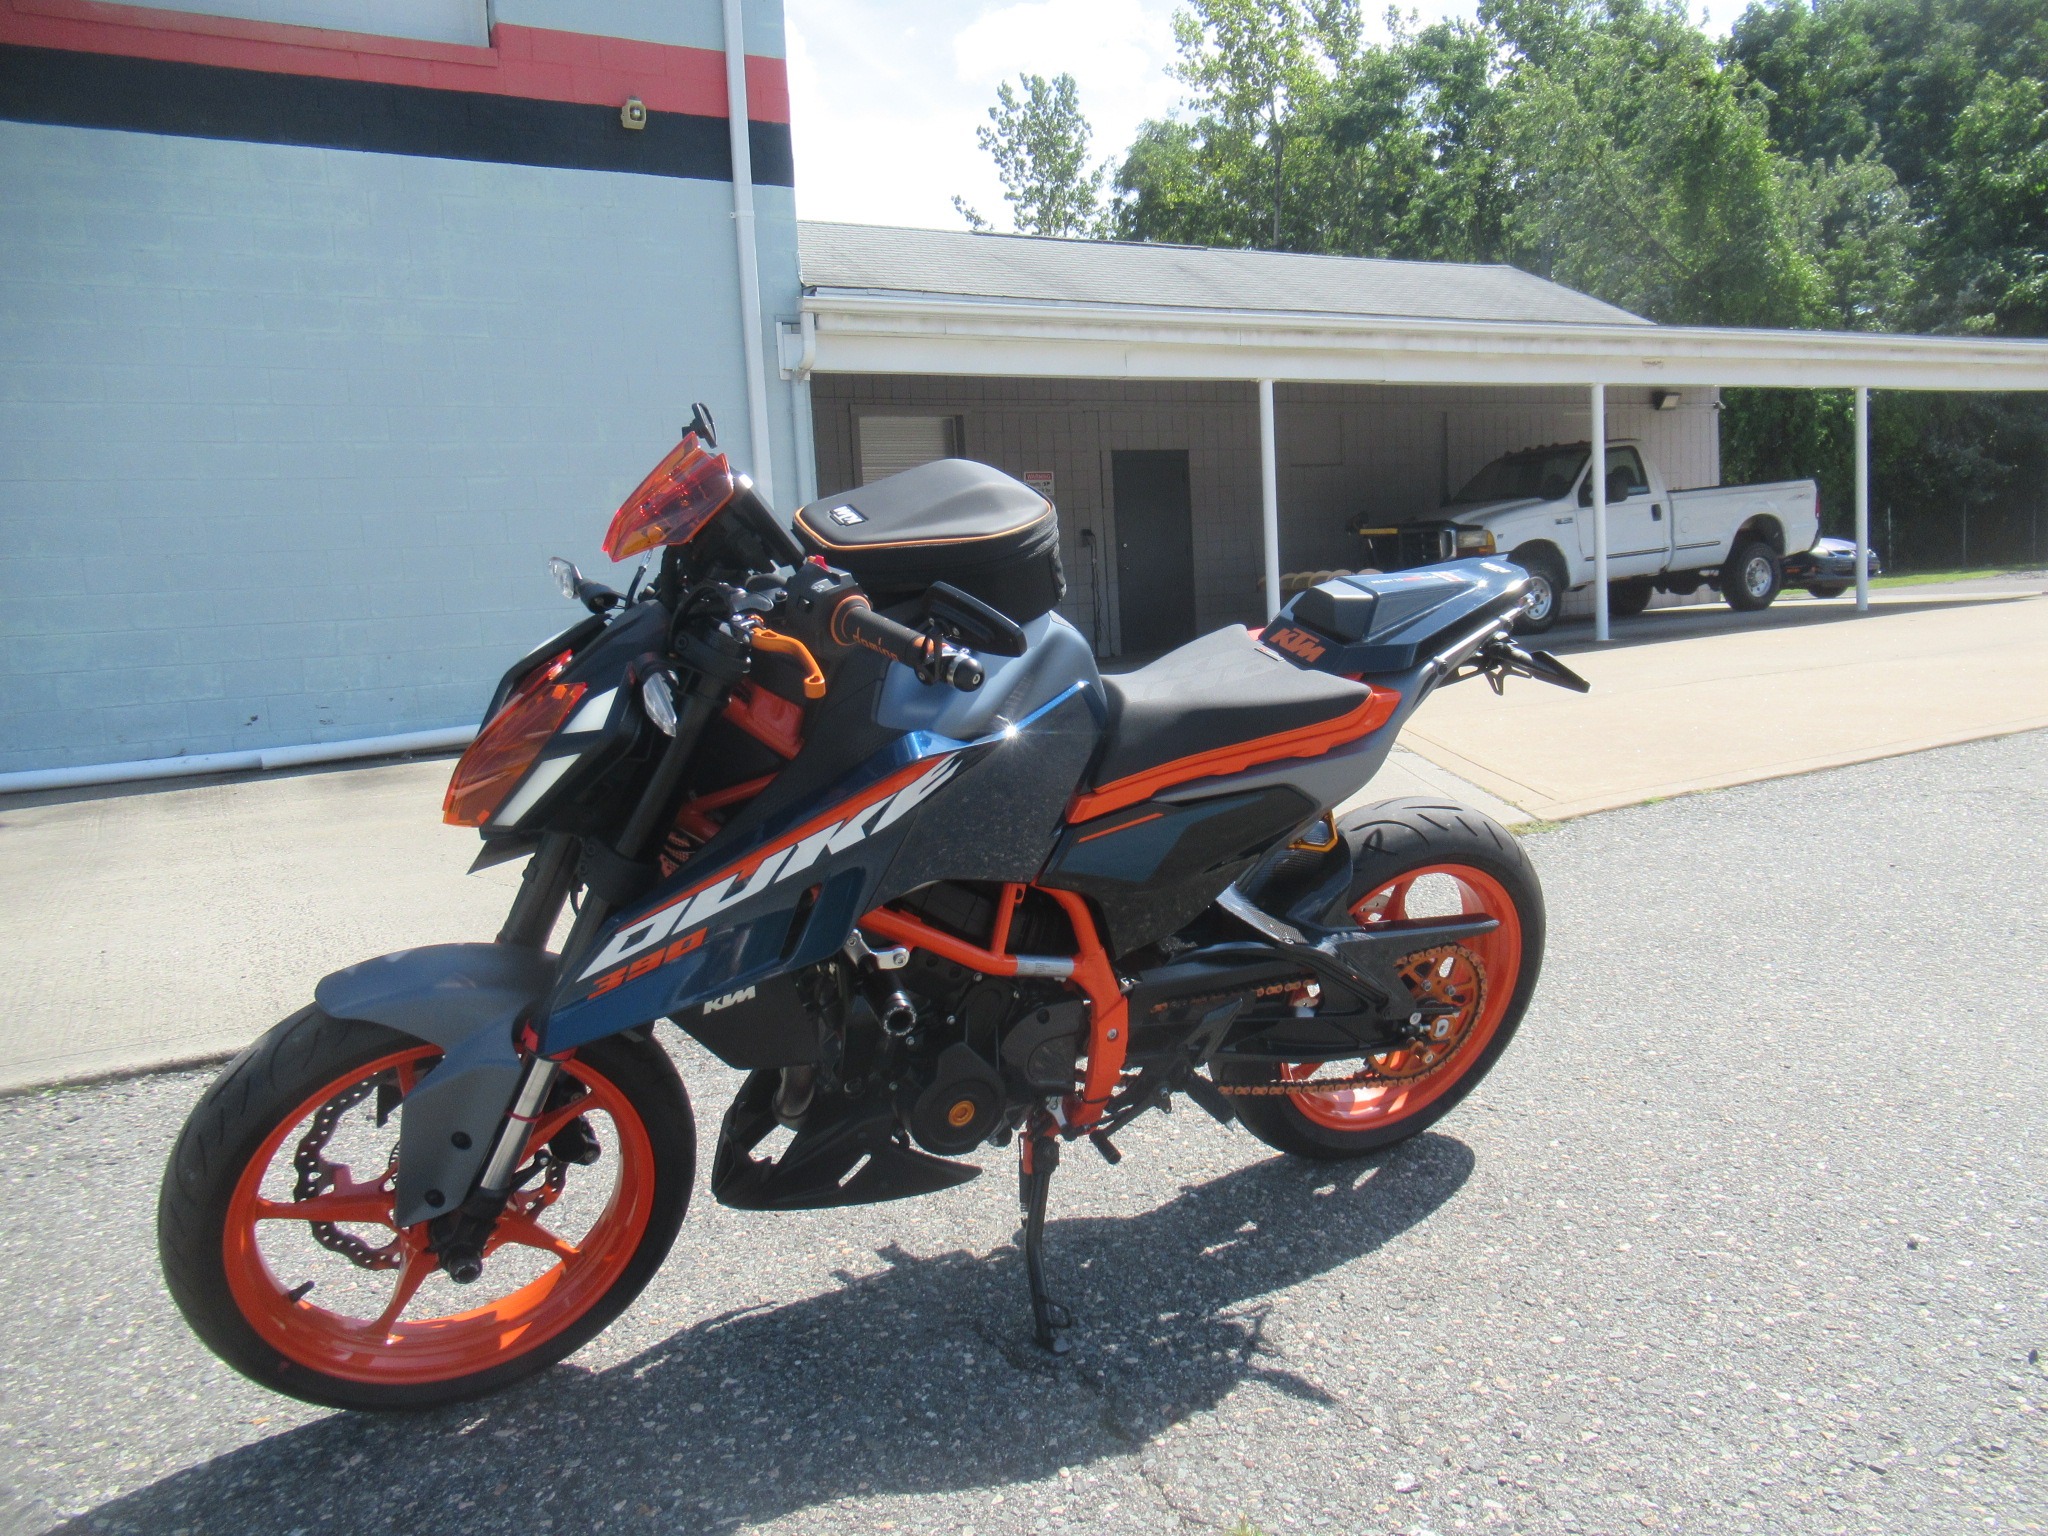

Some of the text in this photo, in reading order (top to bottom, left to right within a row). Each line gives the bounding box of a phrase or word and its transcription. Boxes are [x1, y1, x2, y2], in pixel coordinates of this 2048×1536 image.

[1269, 628, 1326, 662] KTM
[577, 751, 963, 983] DUKE
[587, 927, 708, 1000] 390
[703, 985, 756, 1015] KTM
